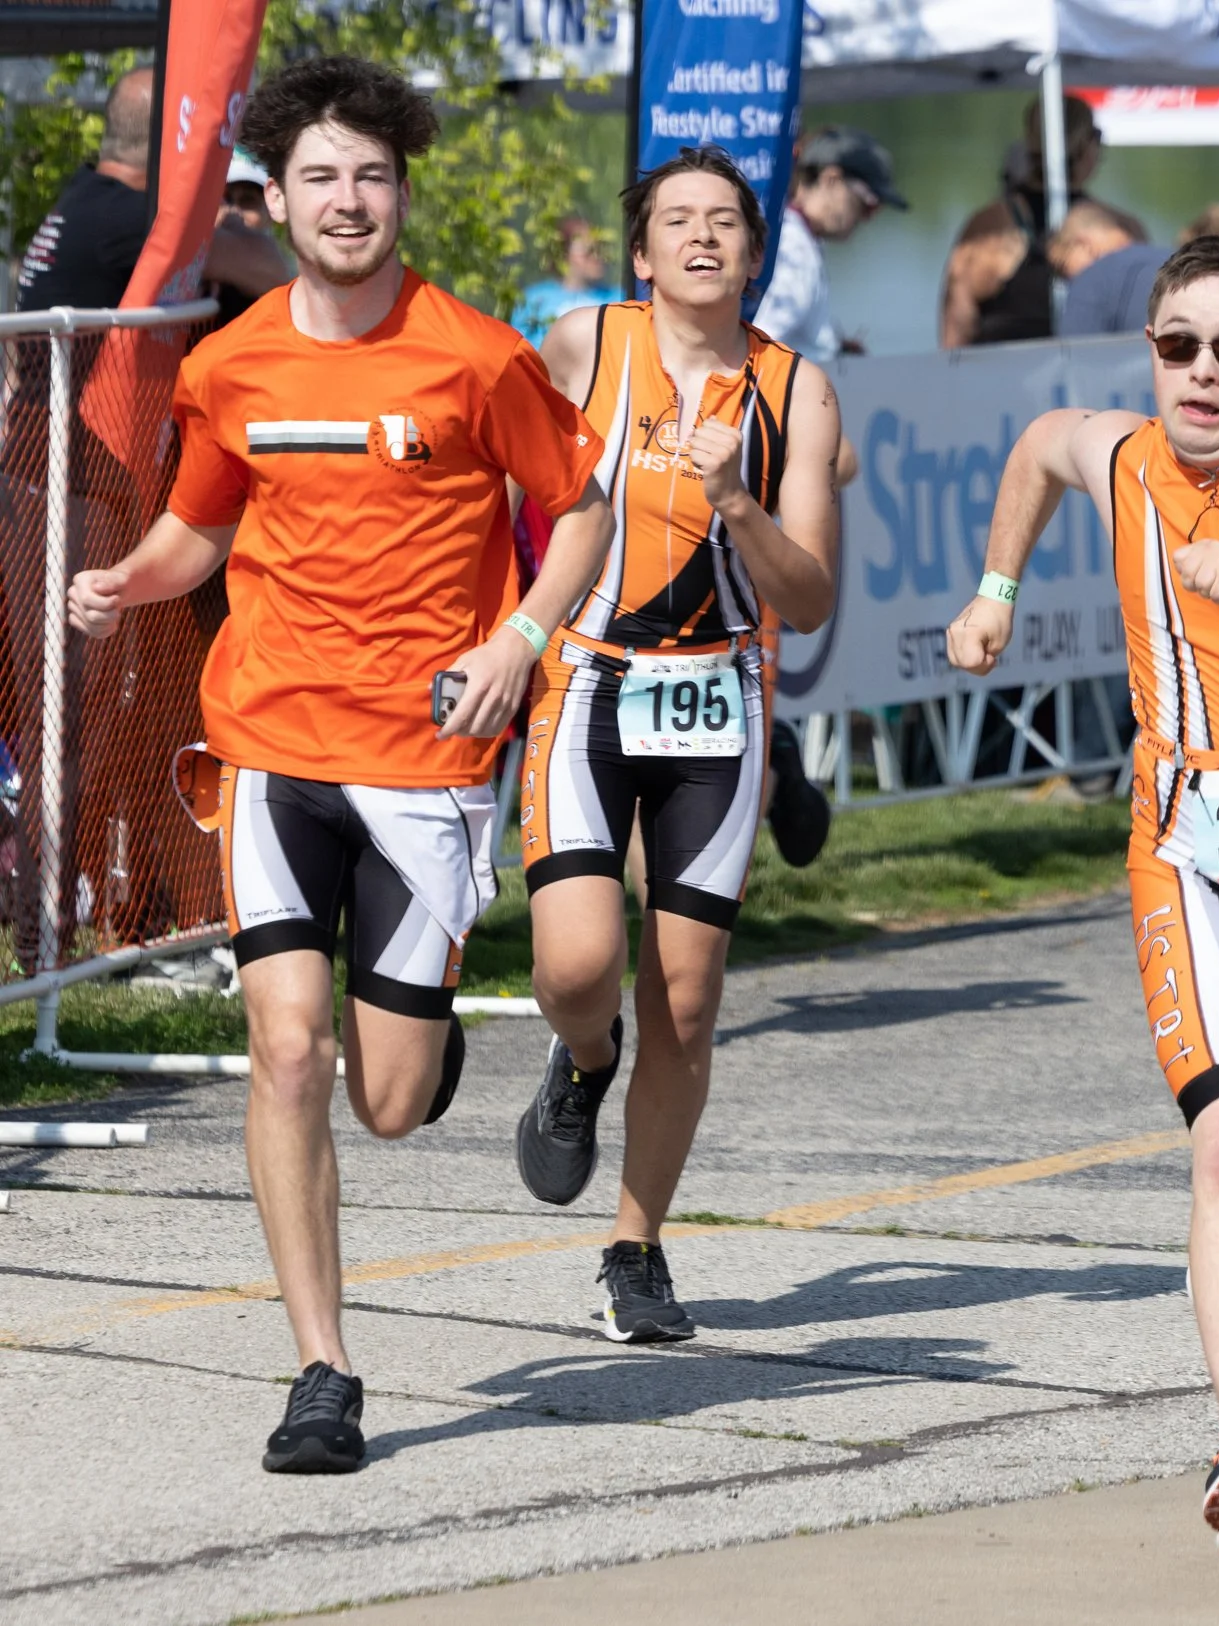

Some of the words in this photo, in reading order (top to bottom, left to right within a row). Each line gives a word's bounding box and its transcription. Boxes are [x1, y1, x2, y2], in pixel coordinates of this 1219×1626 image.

[680, 469, 704, 482] 2019
[997, 583, 1018, 602] 321
[645, 678, 729, 732] 195
